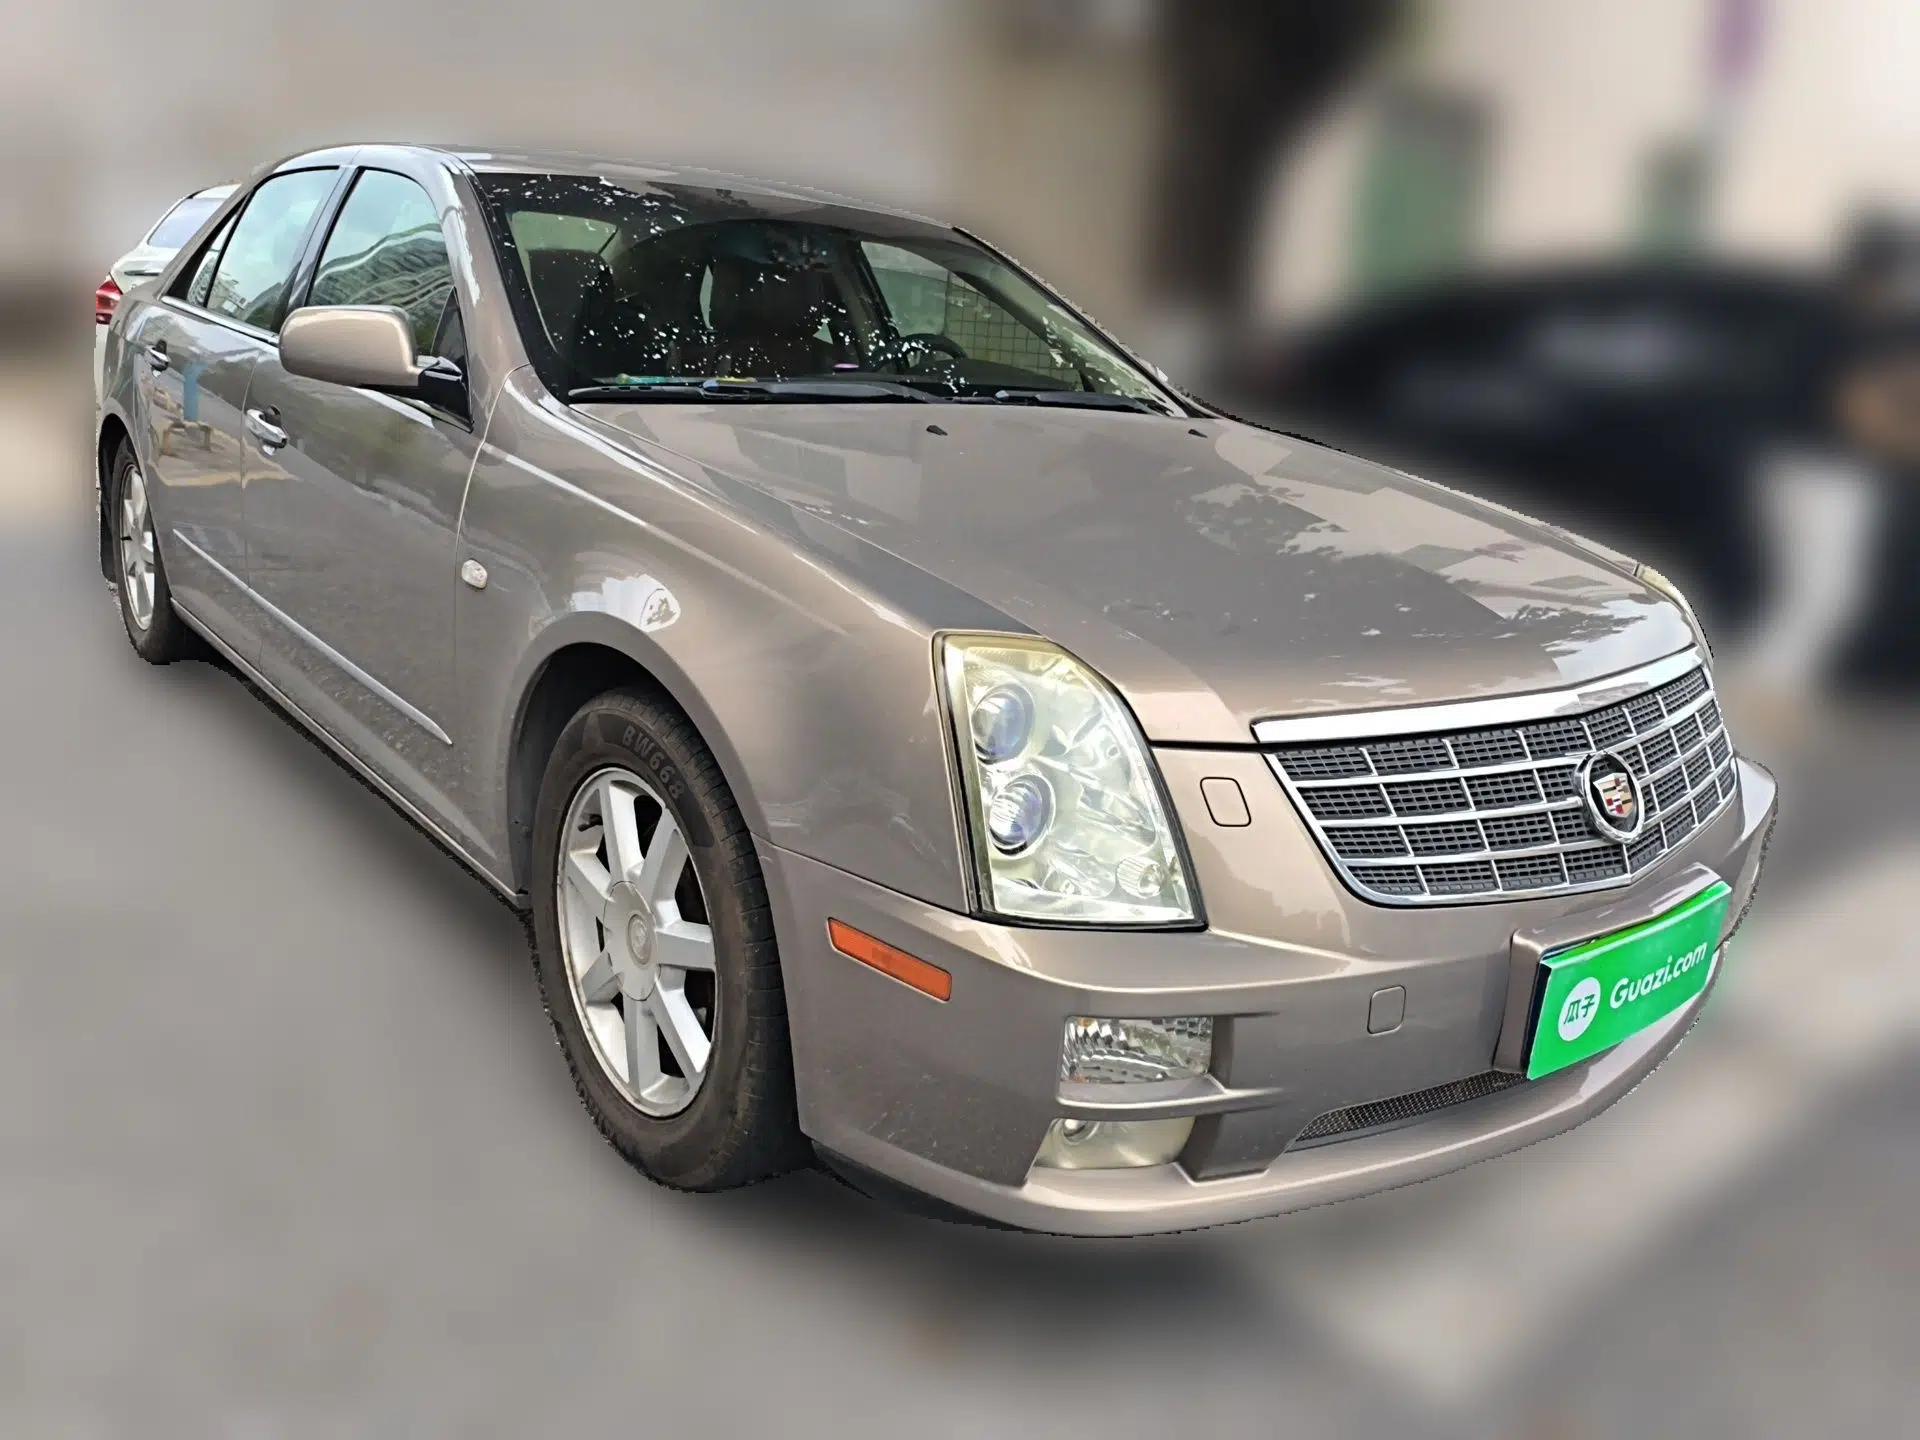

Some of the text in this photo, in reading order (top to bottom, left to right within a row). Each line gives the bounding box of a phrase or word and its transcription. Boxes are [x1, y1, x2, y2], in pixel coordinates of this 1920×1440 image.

[622, 725, 685, 799] BW668
[1563, 942, 1707, 1024] 瓜子 Guazi.com
